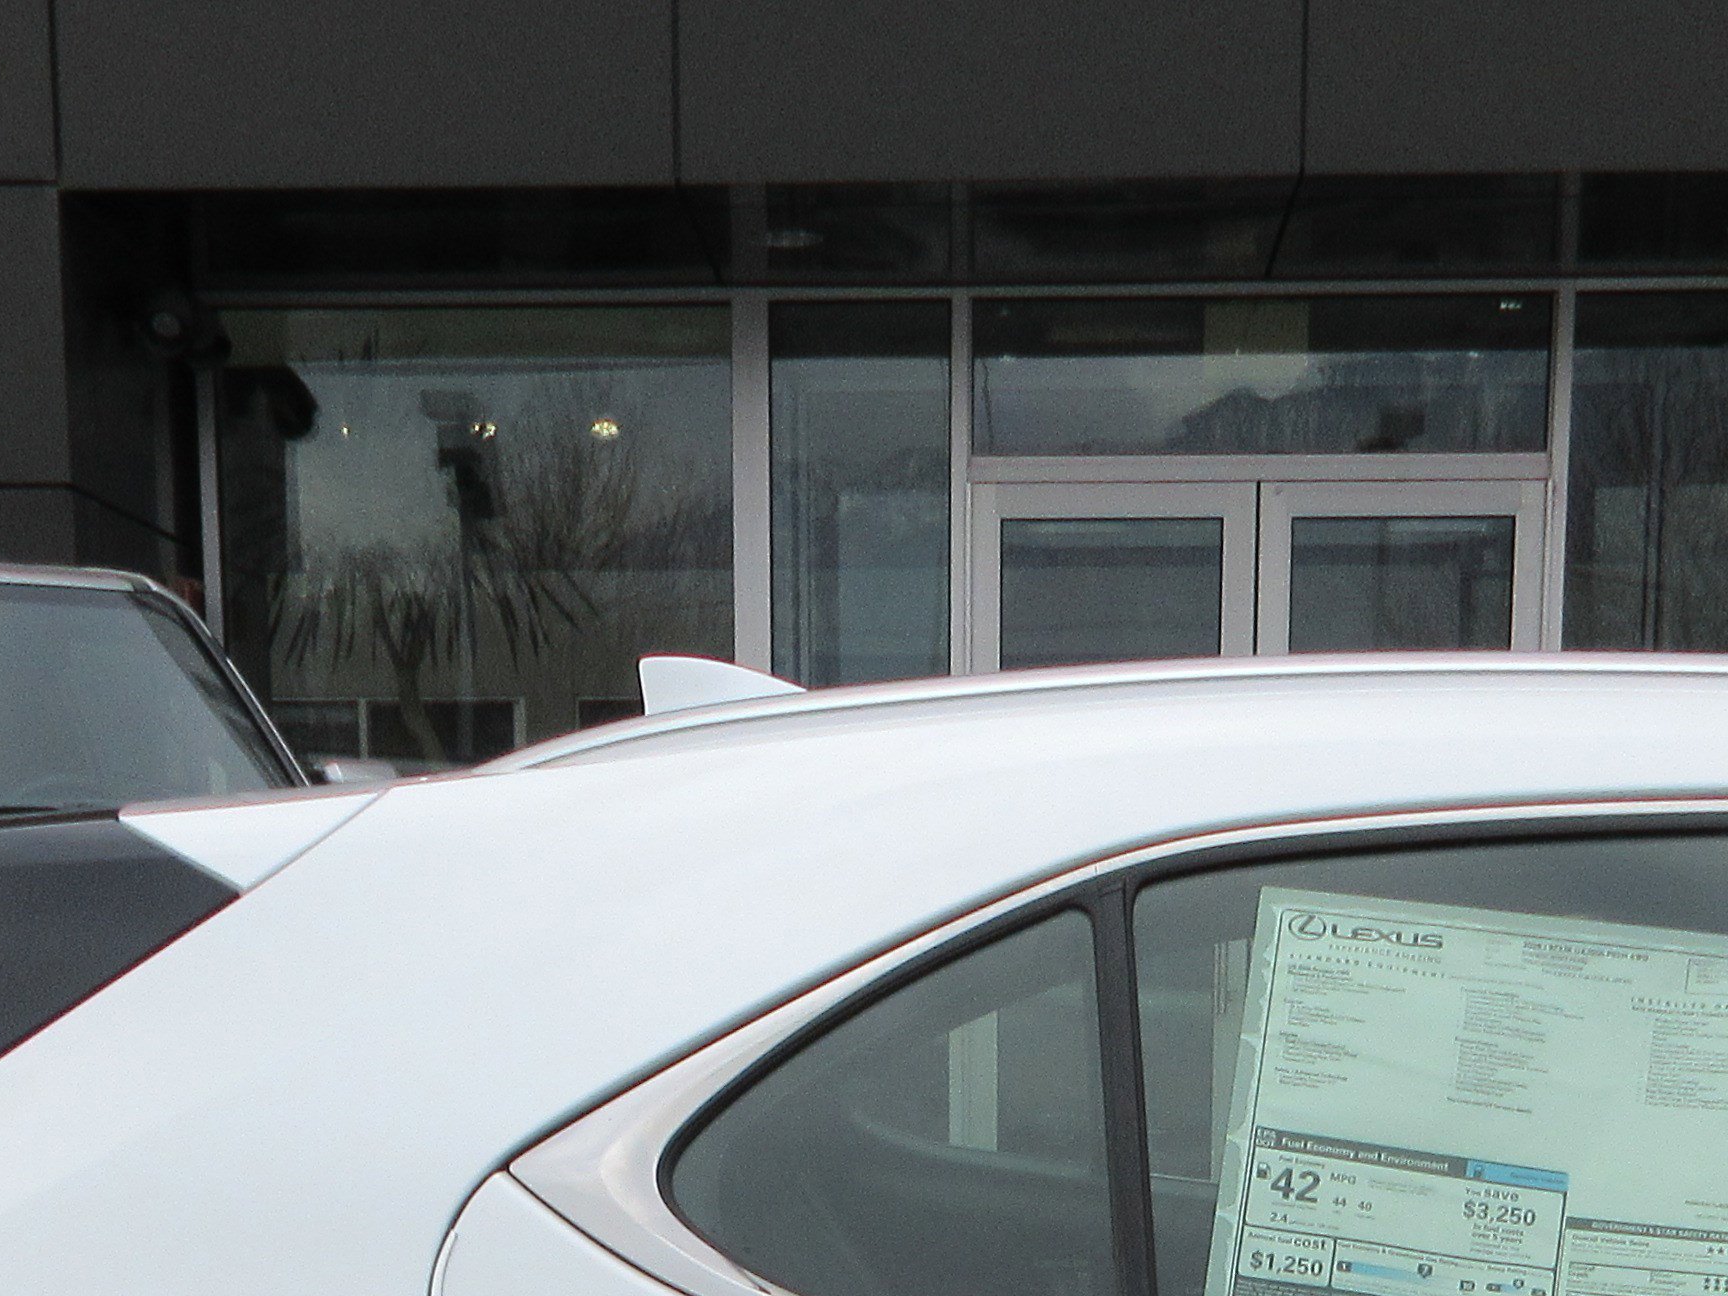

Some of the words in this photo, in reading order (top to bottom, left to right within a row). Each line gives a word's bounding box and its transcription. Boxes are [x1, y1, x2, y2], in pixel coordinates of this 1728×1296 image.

[1331, 923, 1443, 949] LEXUS
[1281, 1137, 1304, 1149] Fuel
[1305, 1141, 1355, 1158] Economy
[1357, 1149, 1379, 1160] and
[1381, 1152, 1449, 1171] Environment
[1270, 1167, 1322, 1204] 42
[1330, 1172, 1357, 1185] MPG
[1332, 1196, 1347, 1207] 44
[1358, 1200, 1373, 1212] 40
[1463, 1200, 1536, 1226] $3,250
[1294, 1237, 1327, 1251] cost
[1250, 1250, 1323, 1277] $1,250
